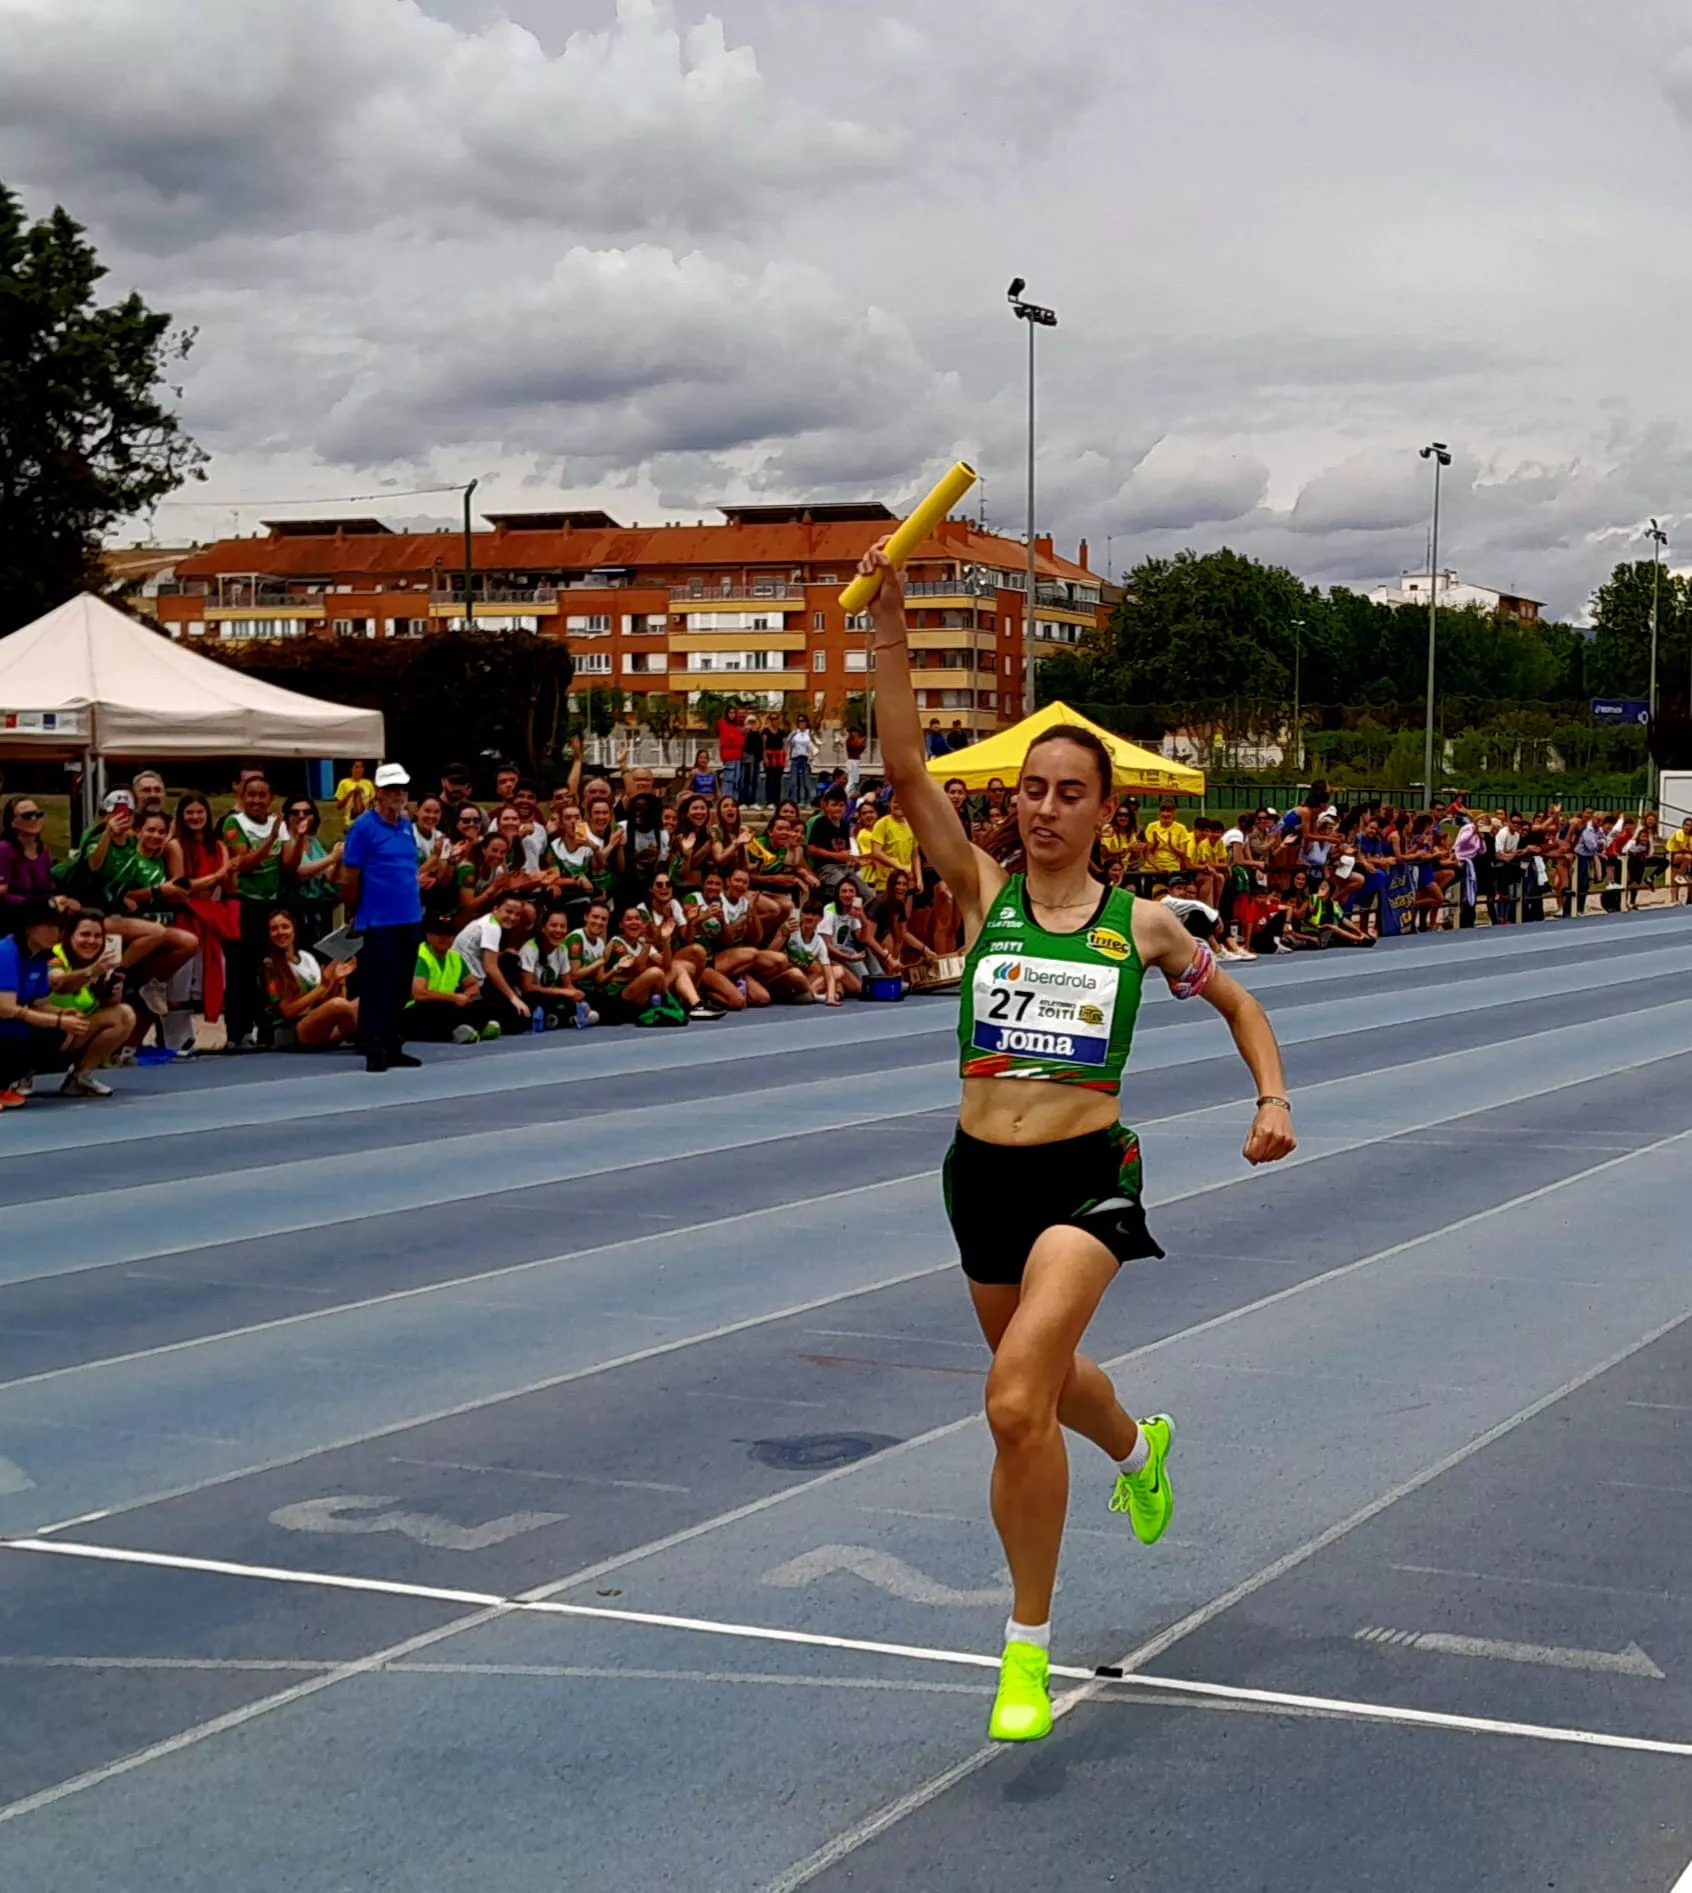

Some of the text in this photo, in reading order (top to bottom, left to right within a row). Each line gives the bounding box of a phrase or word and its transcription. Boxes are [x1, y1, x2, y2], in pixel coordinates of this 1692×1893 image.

[1024, 967, 1097, 990] Iberdrola
[988, 988, 1036, 1022] 27
[1038, 1007, 1075, 1021] ZOITI
